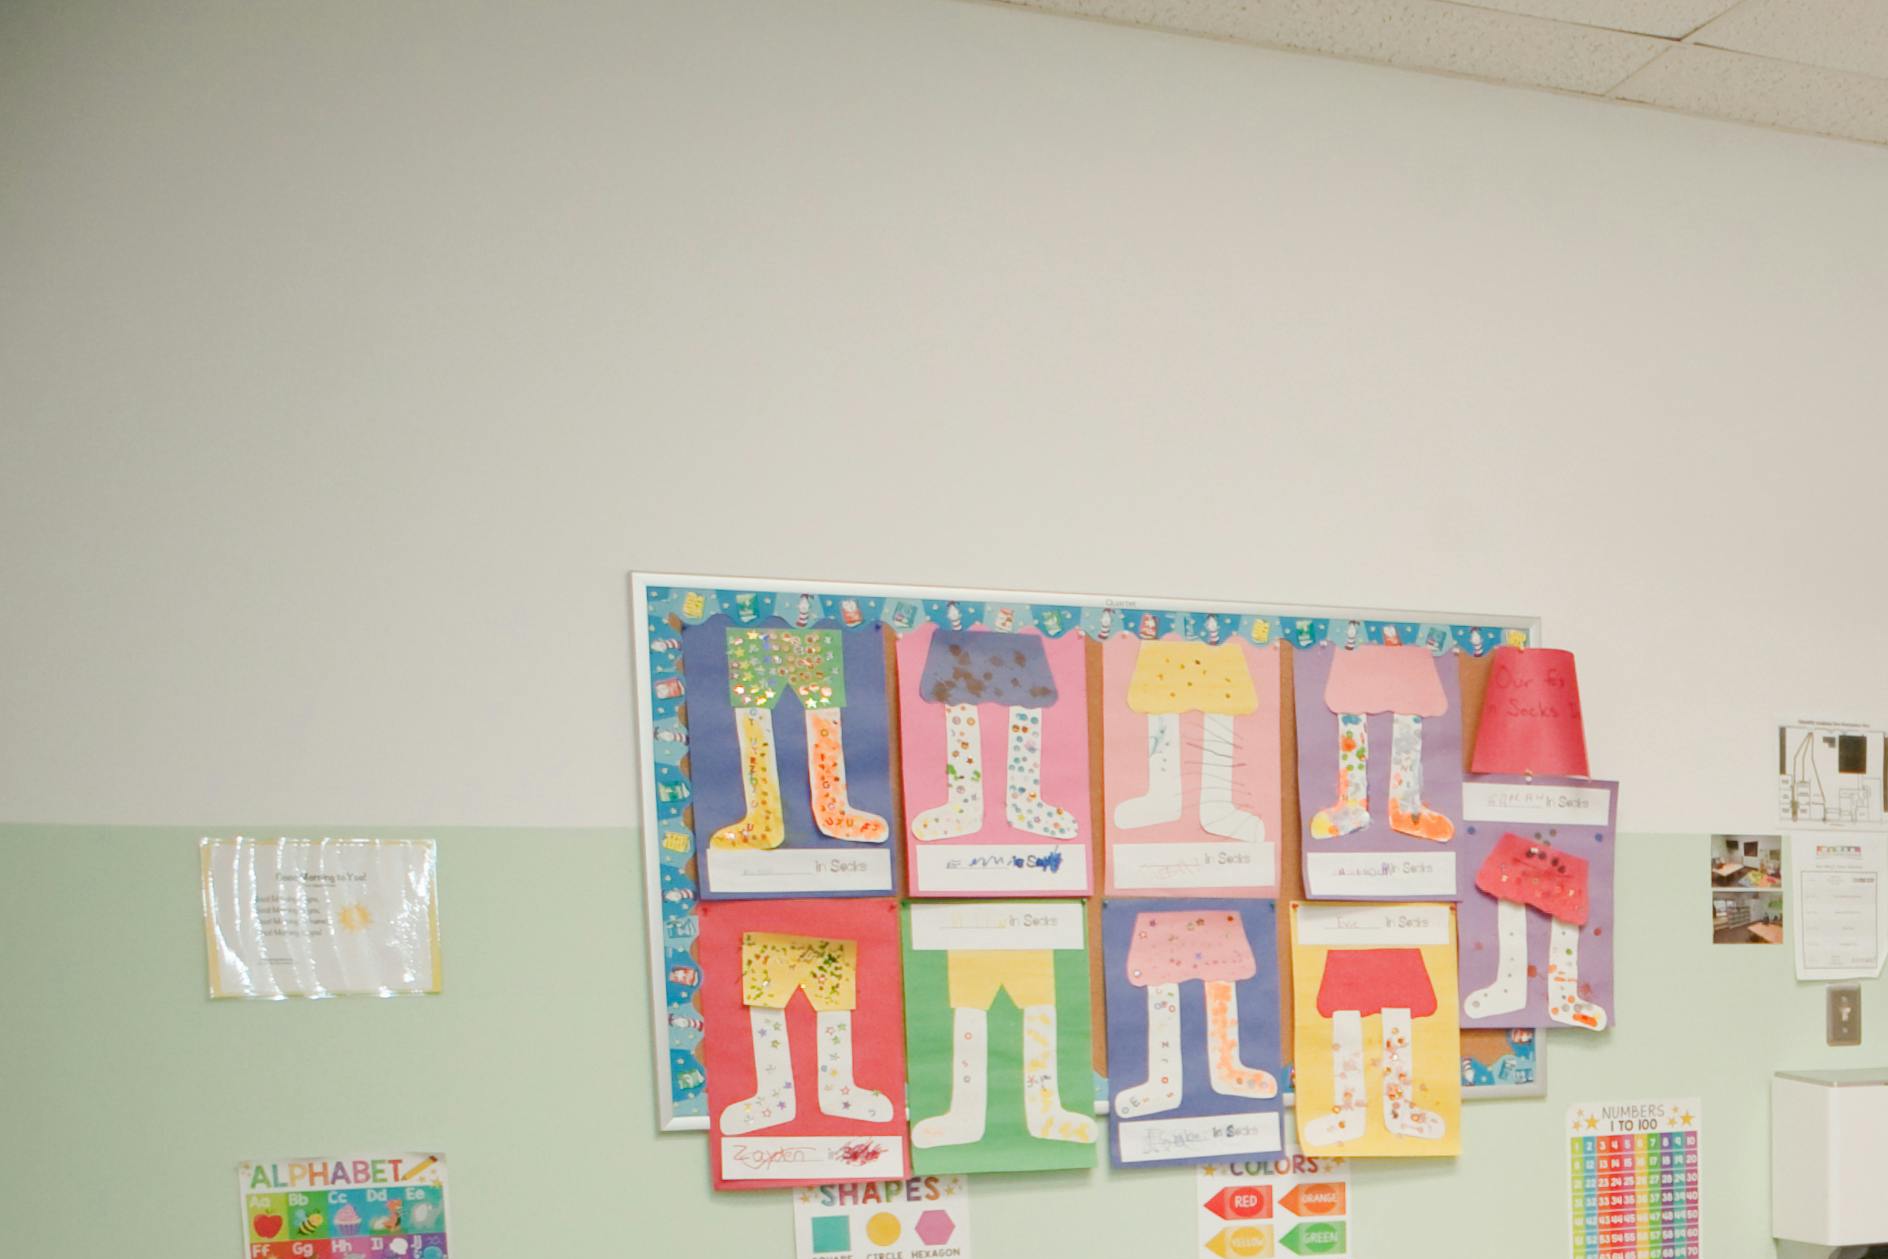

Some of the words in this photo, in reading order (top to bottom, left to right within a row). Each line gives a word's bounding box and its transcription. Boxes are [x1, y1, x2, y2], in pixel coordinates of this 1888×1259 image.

[1495, 666, 1533, 689] Our
[1506, 699, 1559, 717] Socks
[1558, 796, 1589, 808] Socks
[1218, 852, 1251, 864] Socks
[830, 859, 867, 872] Socks
[1403, 863, 1433, 873] Socks
[1024, 914, 1058, 927] Socks
[1398, 916, 1429, 928] Socks
[1602, 1105, 1664, 1119] NUMBERS
[1619, 1120, 1633, 1131] TO
[1638, 1119, 1657, 1131] 100
[1687, 1136, 1695, 1145] 10
[1230, 1154, 1318, 1176] COLORS
[251, 1160, 402, 1188] ALPHABET
[1611, 1178, 1622, 1186] 24
[1687, 1173, 1697, 1182] 30
[289, 1193, 308, 1206] Bb
[328, 1191, 348, 1203] Cc
[367, 1189, 387, 1201] Dd
[406, 1187, 424, 1199] Ee
[820, 1177, 940, 1206] SHAPES
[1235, 1195, 1257, 1208] RED
[1303, 1194, 1336, 1203] ORANGE
[1304, 1231, 1338, 1243] GREEN
[253, 1245, 270, 1257] Ff
[292, 1243, 313, 1257] Gg
[332, 1240, 352, 1252] Hh
[911, 1248, 960, 1259] HEXAGON
